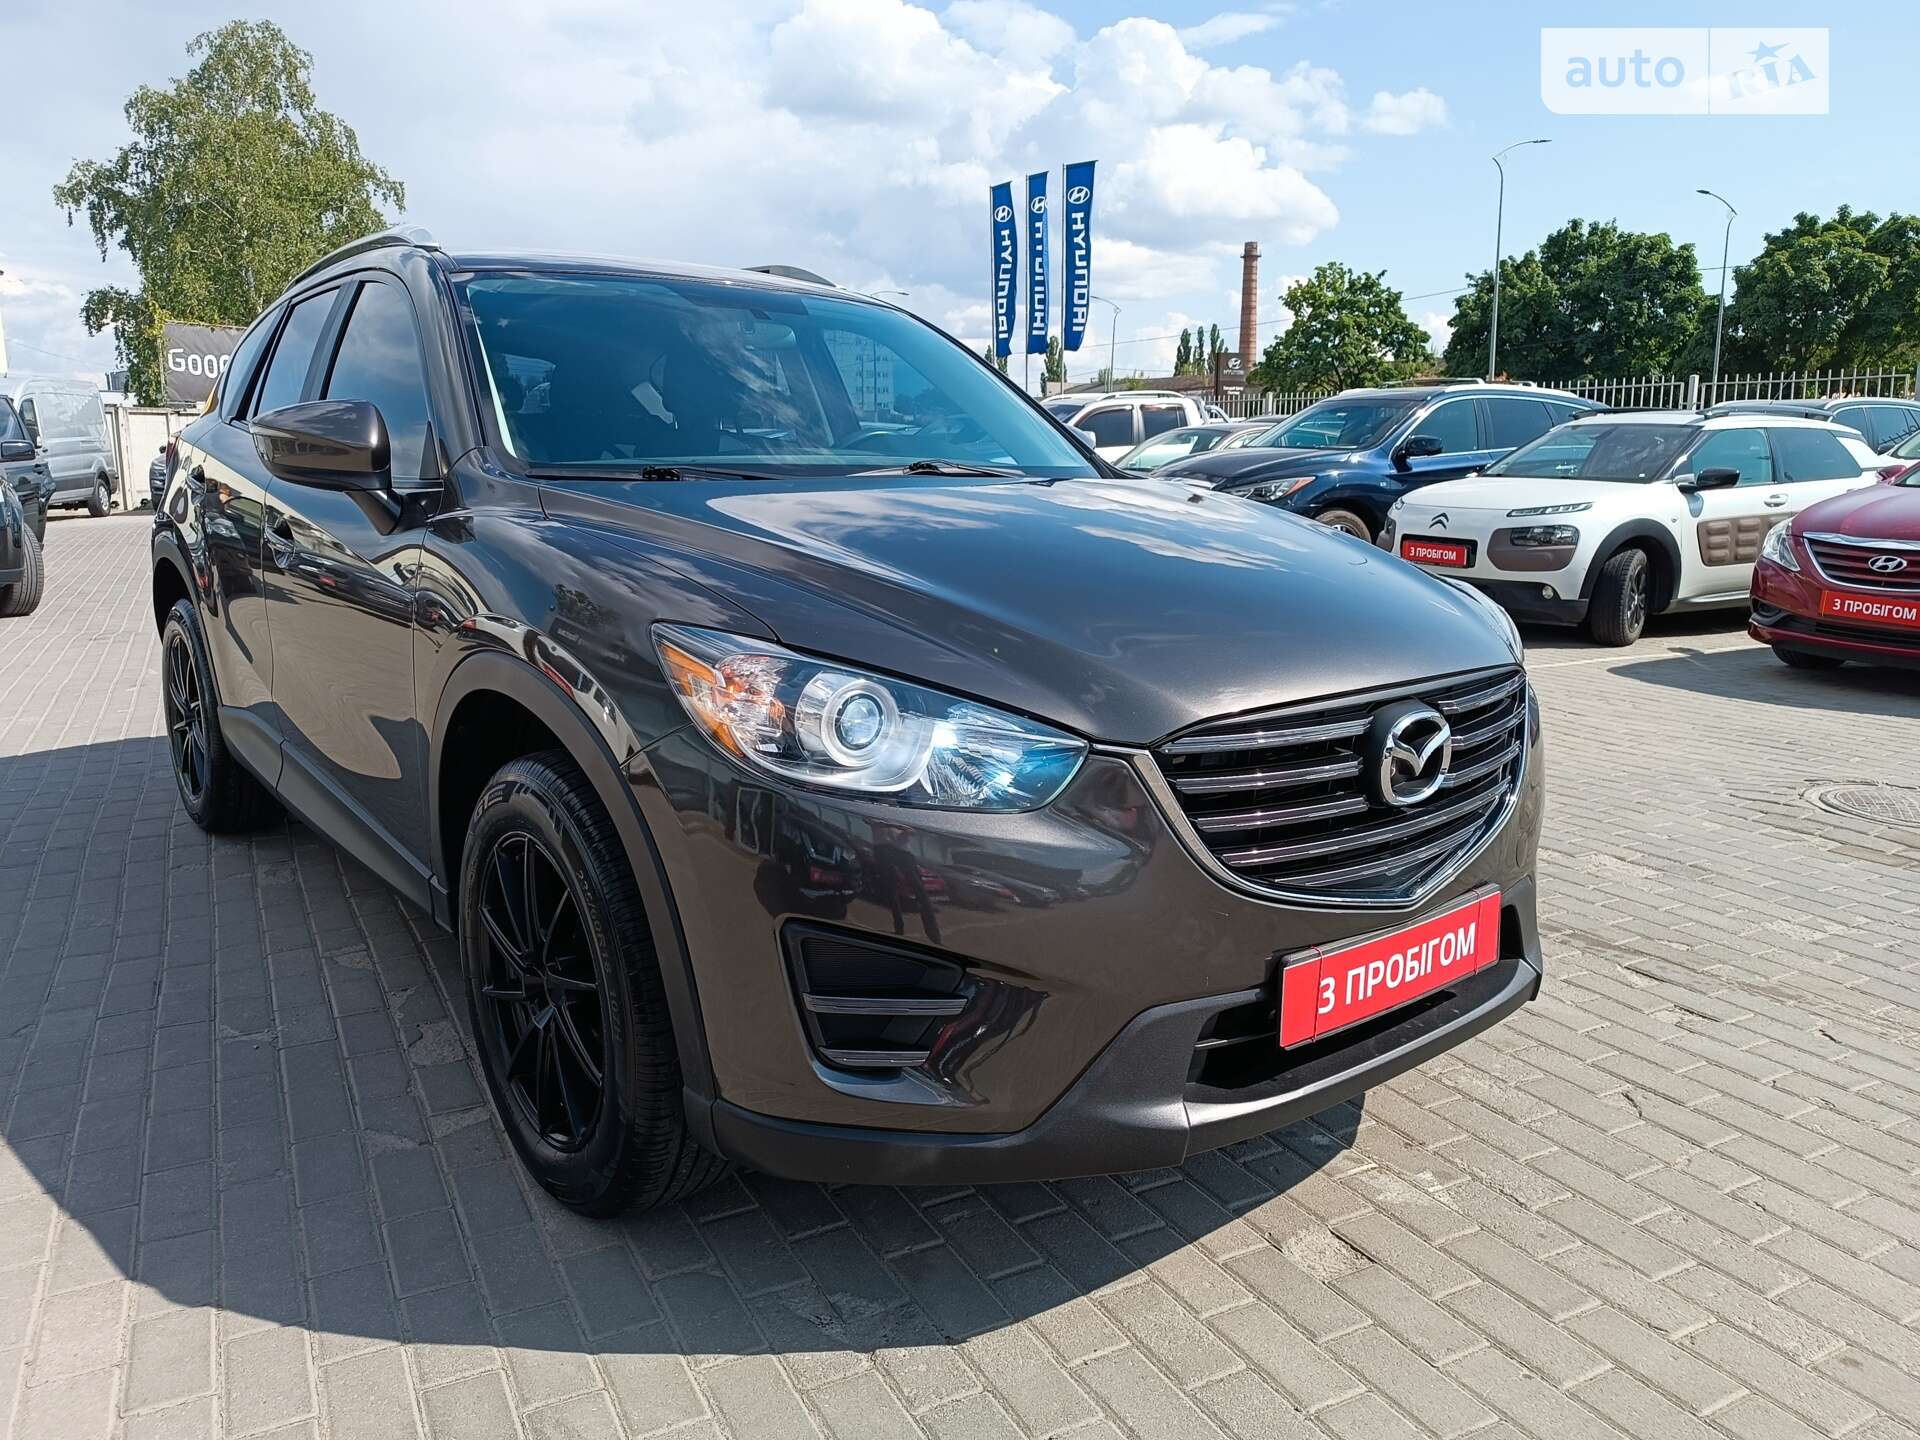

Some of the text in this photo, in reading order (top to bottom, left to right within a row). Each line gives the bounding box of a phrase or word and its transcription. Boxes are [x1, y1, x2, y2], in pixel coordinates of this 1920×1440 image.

[996, 229, 1013, 339] HYUNDAI
[1071, 211, 1089, 332] HYUNDAI
[1416, 547, 1457, 561] ПРОБІГОМ
[1832, 598, 1917, 621] З ПРОБІГОМ
[1317, 922, 1476, 1014] З ПРОБІГОМ
